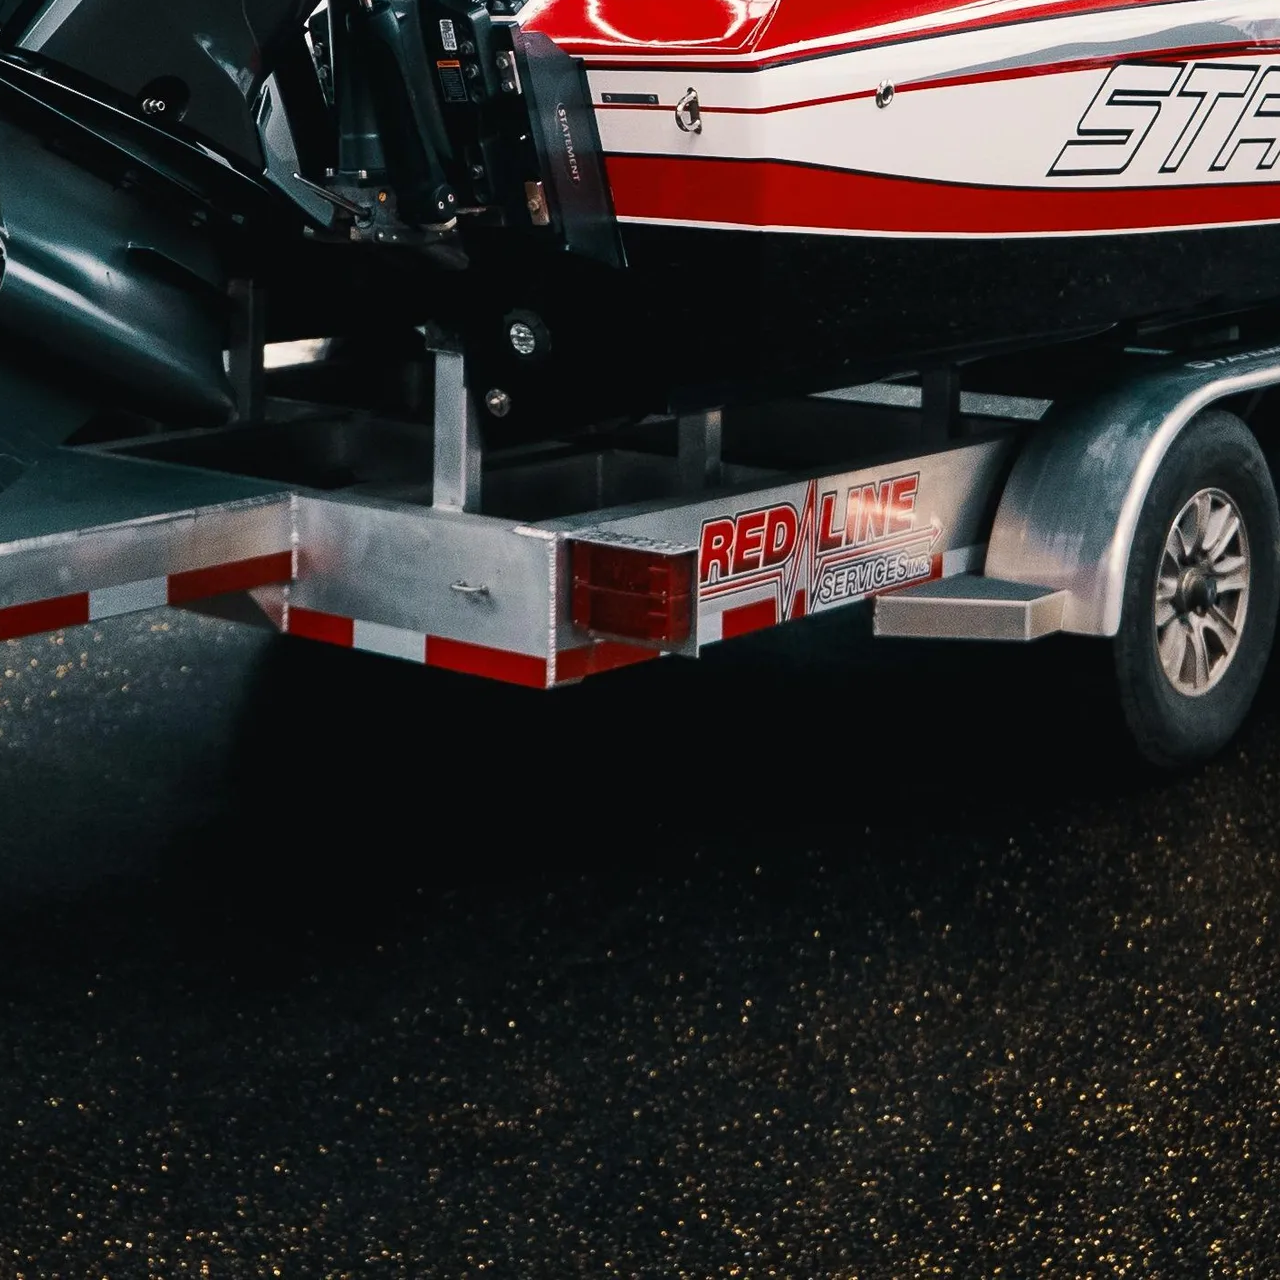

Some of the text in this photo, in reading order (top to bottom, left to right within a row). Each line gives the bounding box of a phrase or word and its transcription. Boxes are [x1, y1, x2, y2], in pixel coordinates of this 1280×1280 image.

[558, 108, 581, 182] STATEMENT
[701, 472, 920, 582] RED LINE
[820, 552, 908, 603] SERVICES
